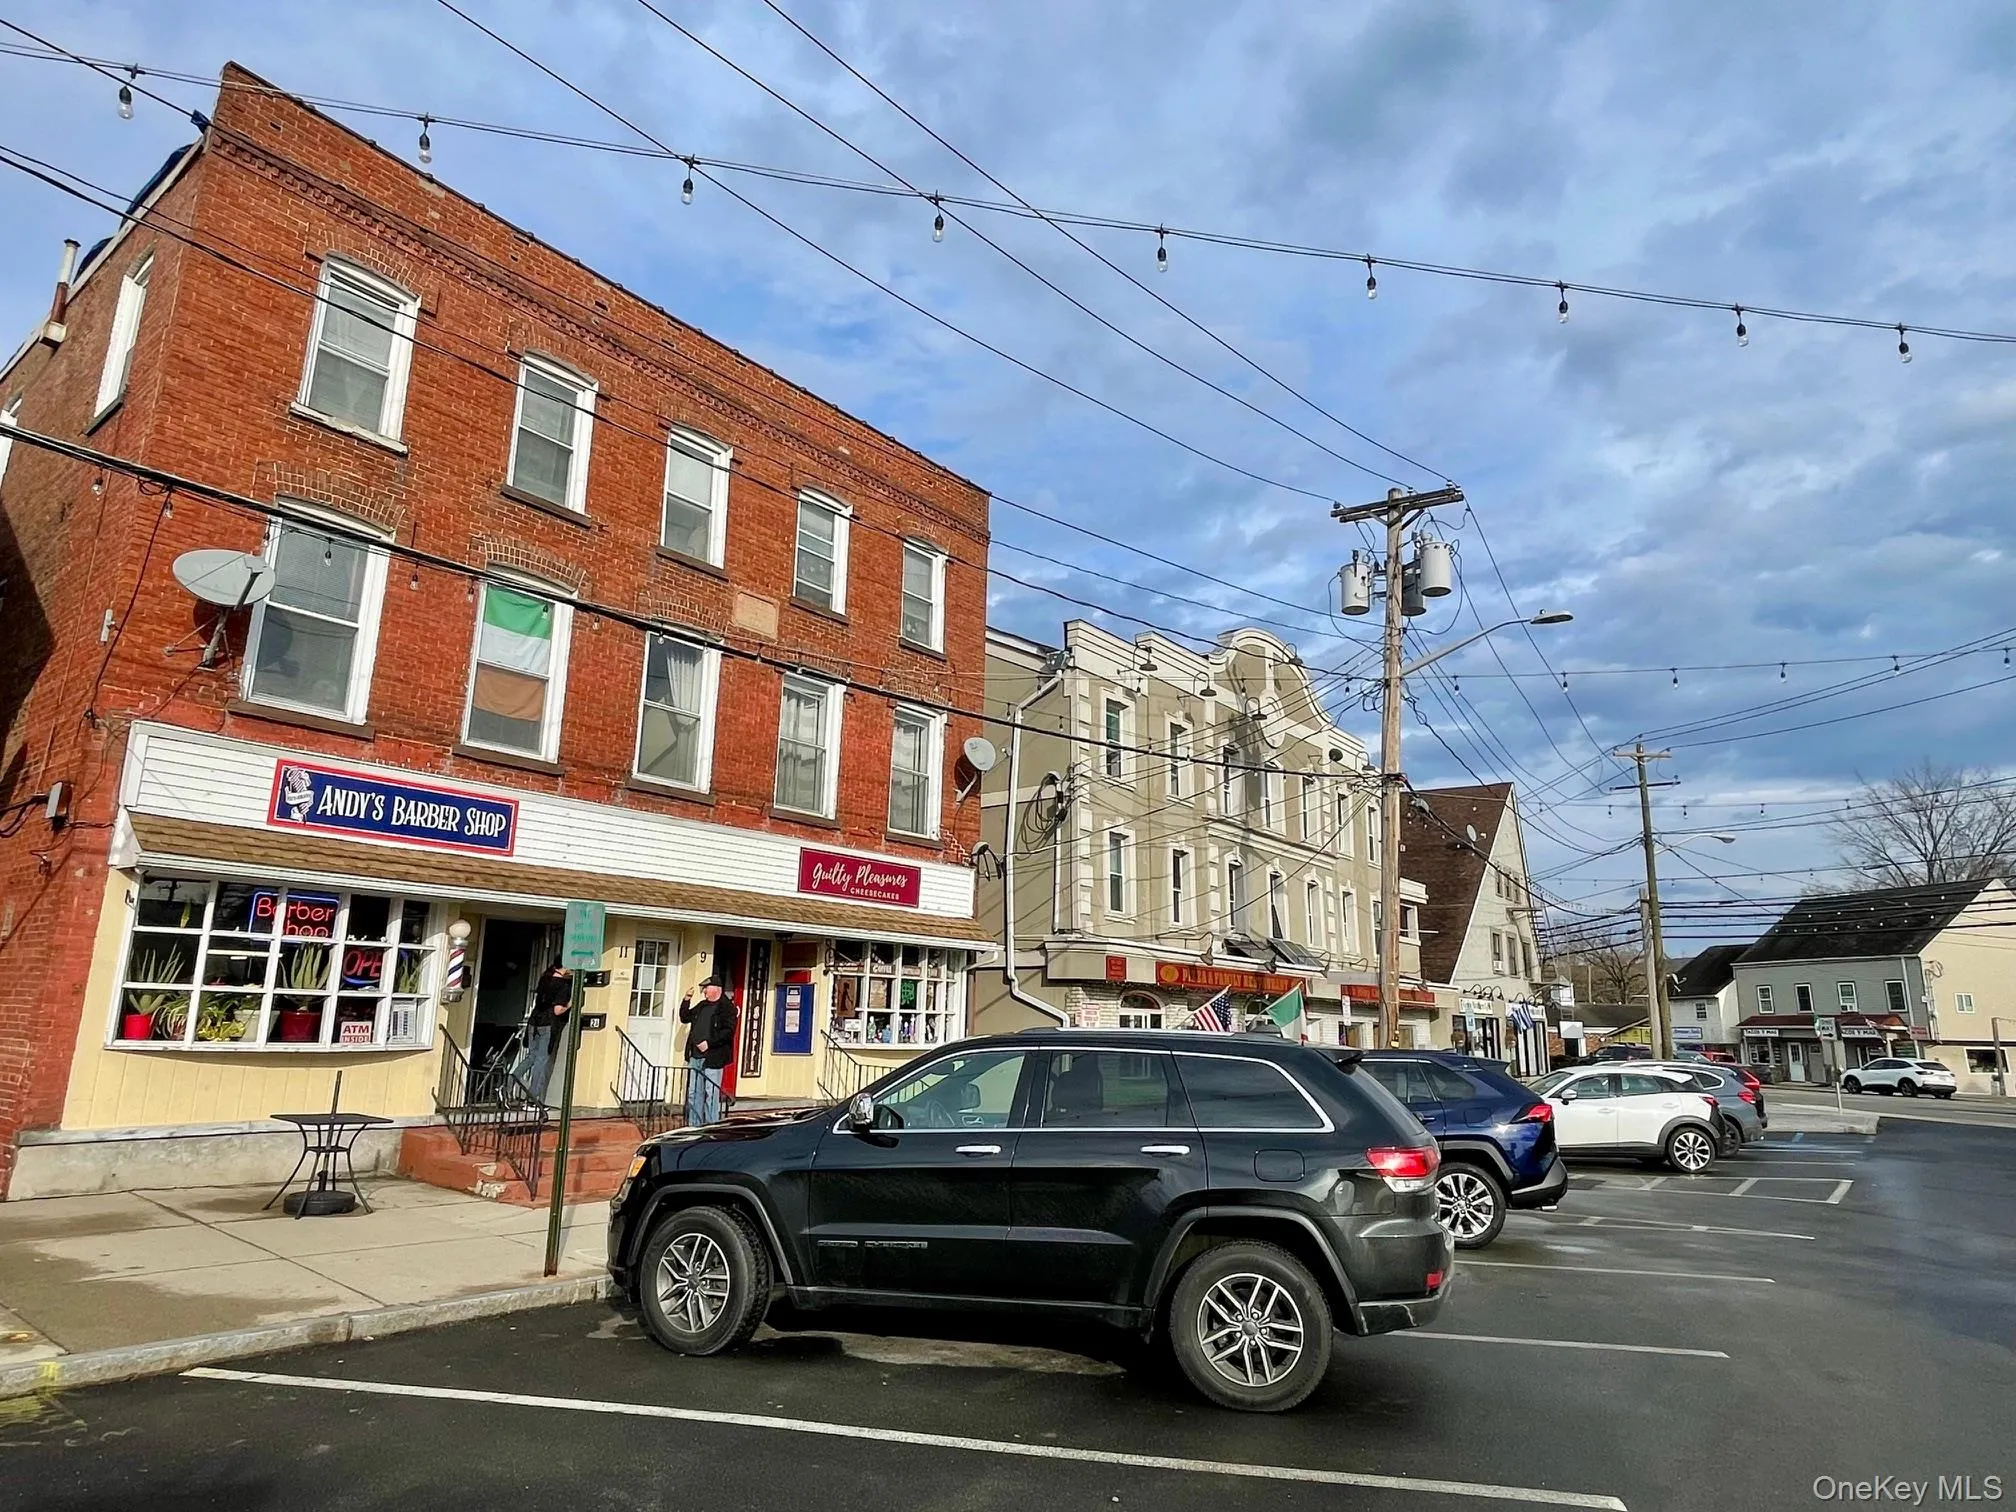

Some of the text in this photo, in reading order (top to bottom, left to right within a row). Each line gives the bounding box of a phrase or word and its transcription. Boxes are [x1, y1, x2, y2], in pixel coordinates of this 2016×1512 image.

[316, 785, 507, 838] ANDY'S BARBER SHOP
[812, 862, 908, 891] Guilty Pleasures
[850, 887, 899, 900] CHEESECAKES
[700, 951, 707, 963] 9
[343, 1025, 370, 1034] ATM
